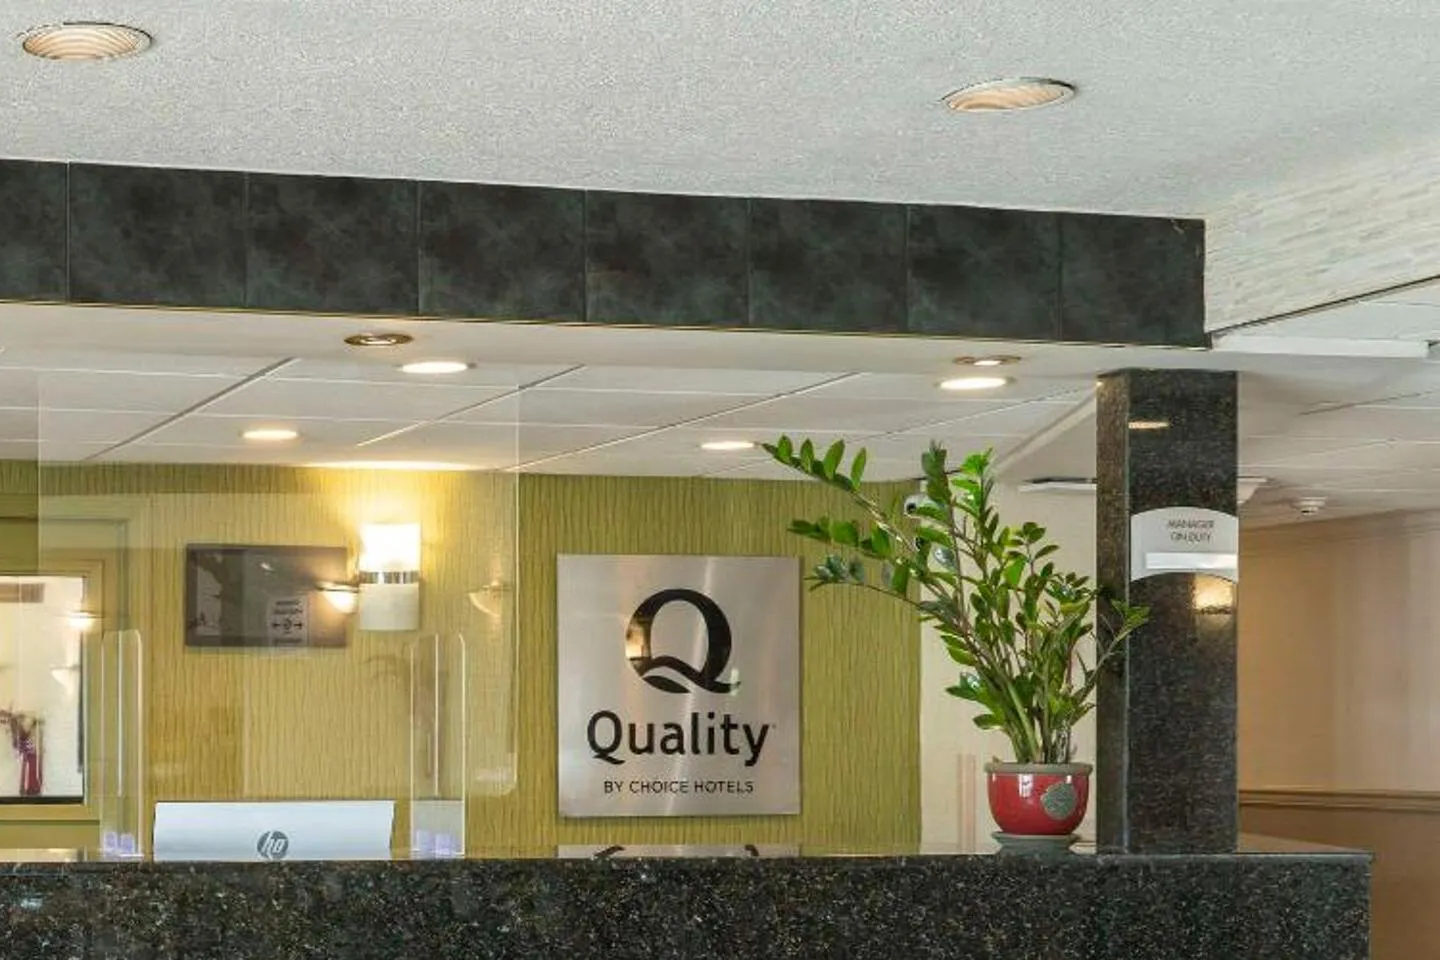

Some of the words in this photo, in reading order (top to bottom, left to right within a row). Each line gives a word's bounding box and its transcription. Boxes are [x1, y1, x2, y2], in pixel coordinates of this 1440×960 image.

[625, 588, 741, 694] Q
[587, 710, 770, 767] Quality
[604, 781, 623, 793] BY
[629, 781, 689, 793] CHOICE
[694, 781, 754, 793] HOTELS
[258, 830, 288, 860] hp
